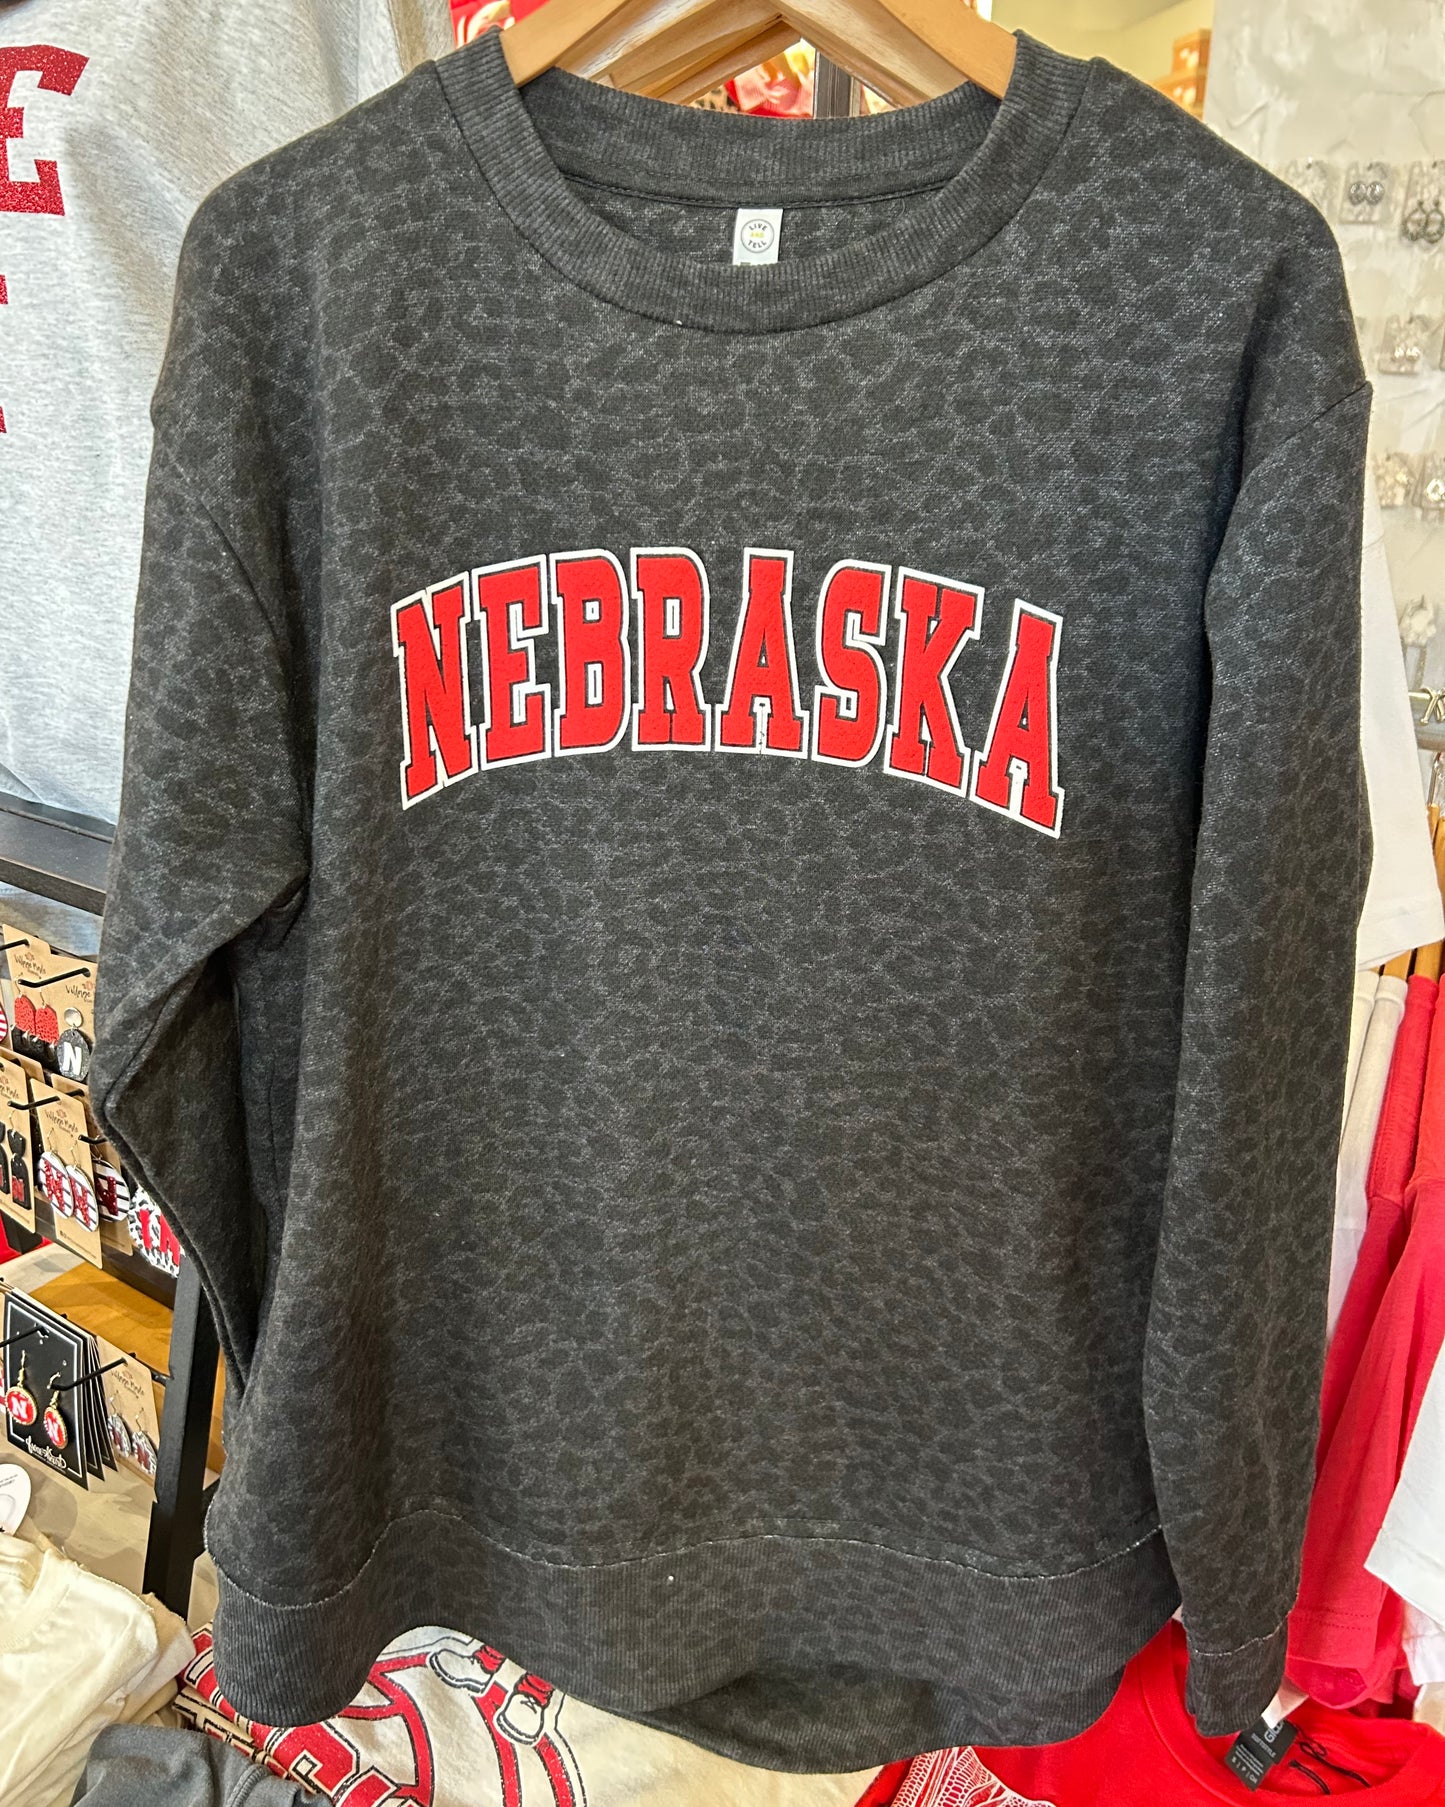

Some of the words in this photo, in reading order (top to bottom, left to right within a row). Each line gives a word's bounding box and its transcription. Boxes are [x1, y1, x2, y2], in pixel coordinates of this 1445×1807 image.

[748, 223, 768, 231] LIVE
[747, 240, 767, 248] TELL
[390, 546, 1065, 839] NEBRASKA
[62, 1041, 82, 1076] N
[11, 1395, 28, 1420] N
[47, 1416, 61, 1441] N
